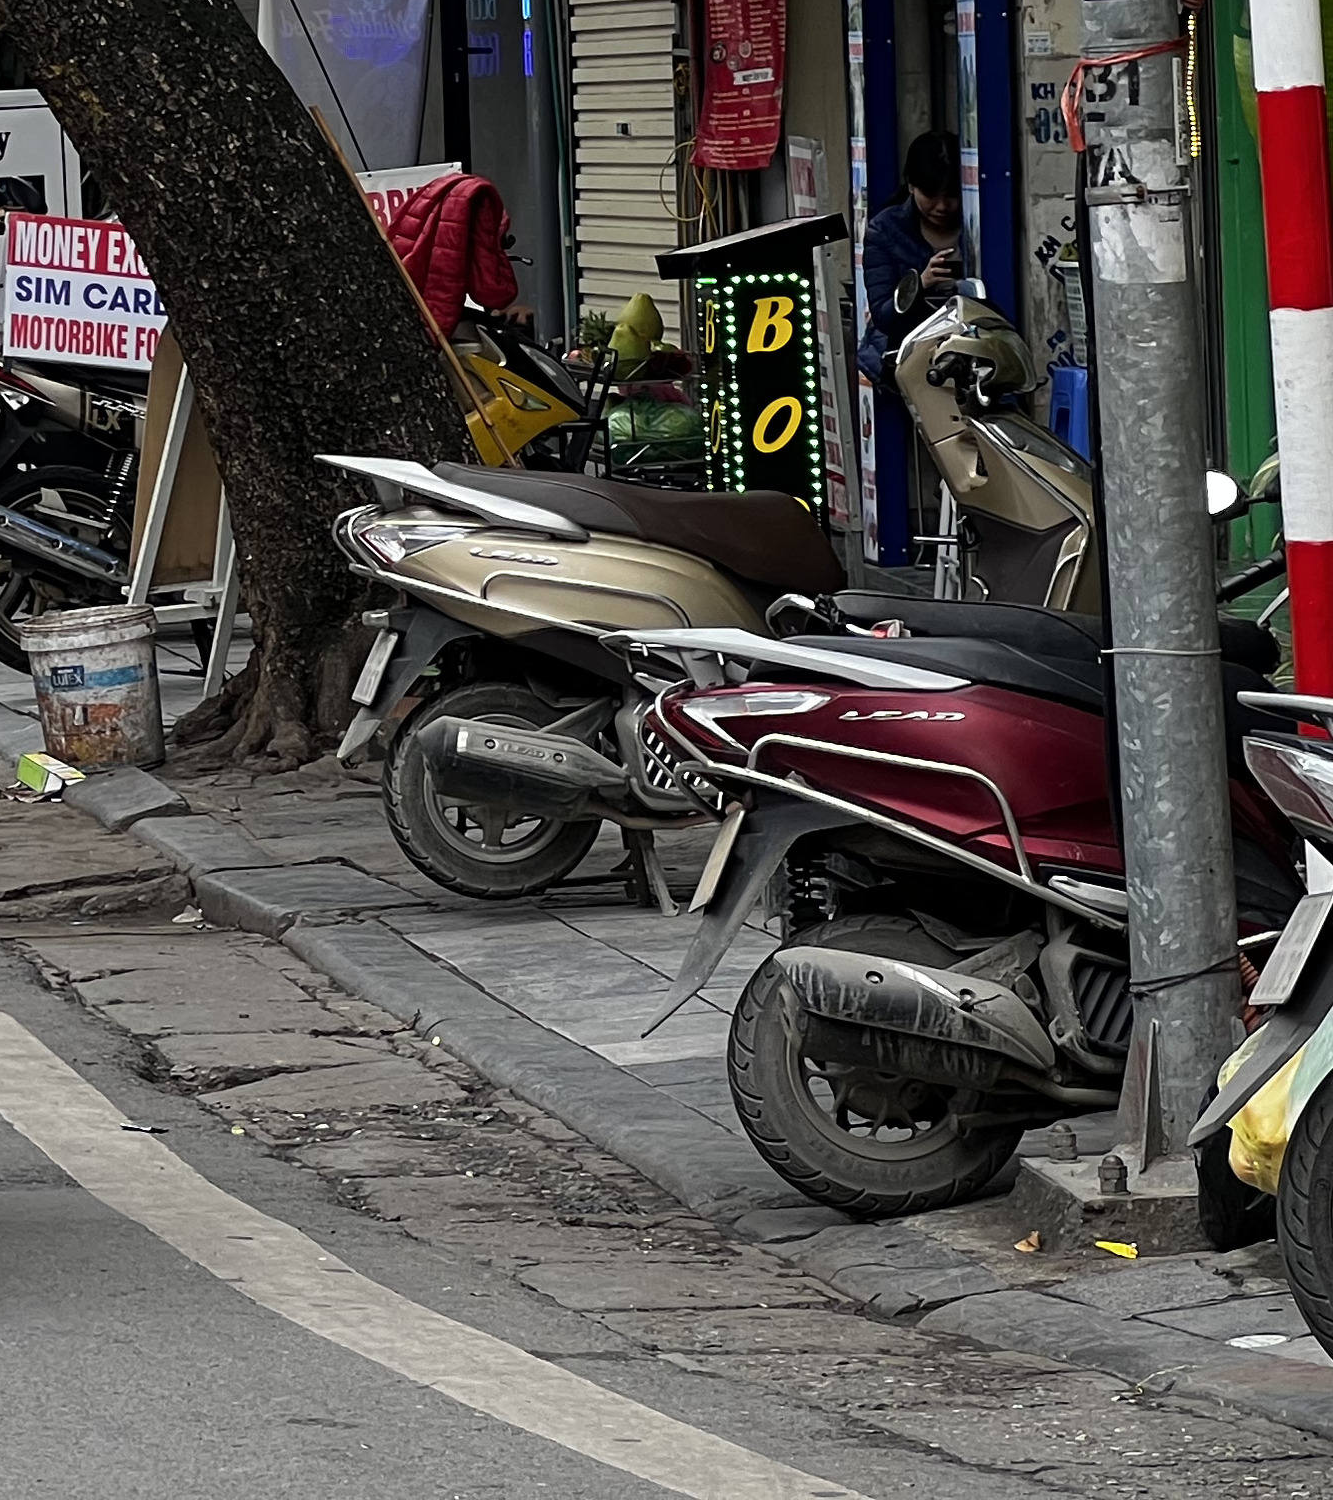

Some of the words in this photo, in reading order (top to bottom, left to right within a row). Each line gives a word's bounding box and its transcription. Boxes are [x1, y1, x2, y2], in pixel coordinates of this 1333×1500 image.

[14, 220, 102, 270] MONEY
[15, 275, 71, 306] SIM
[10, 313, 129, 360] MOTORBIKE
